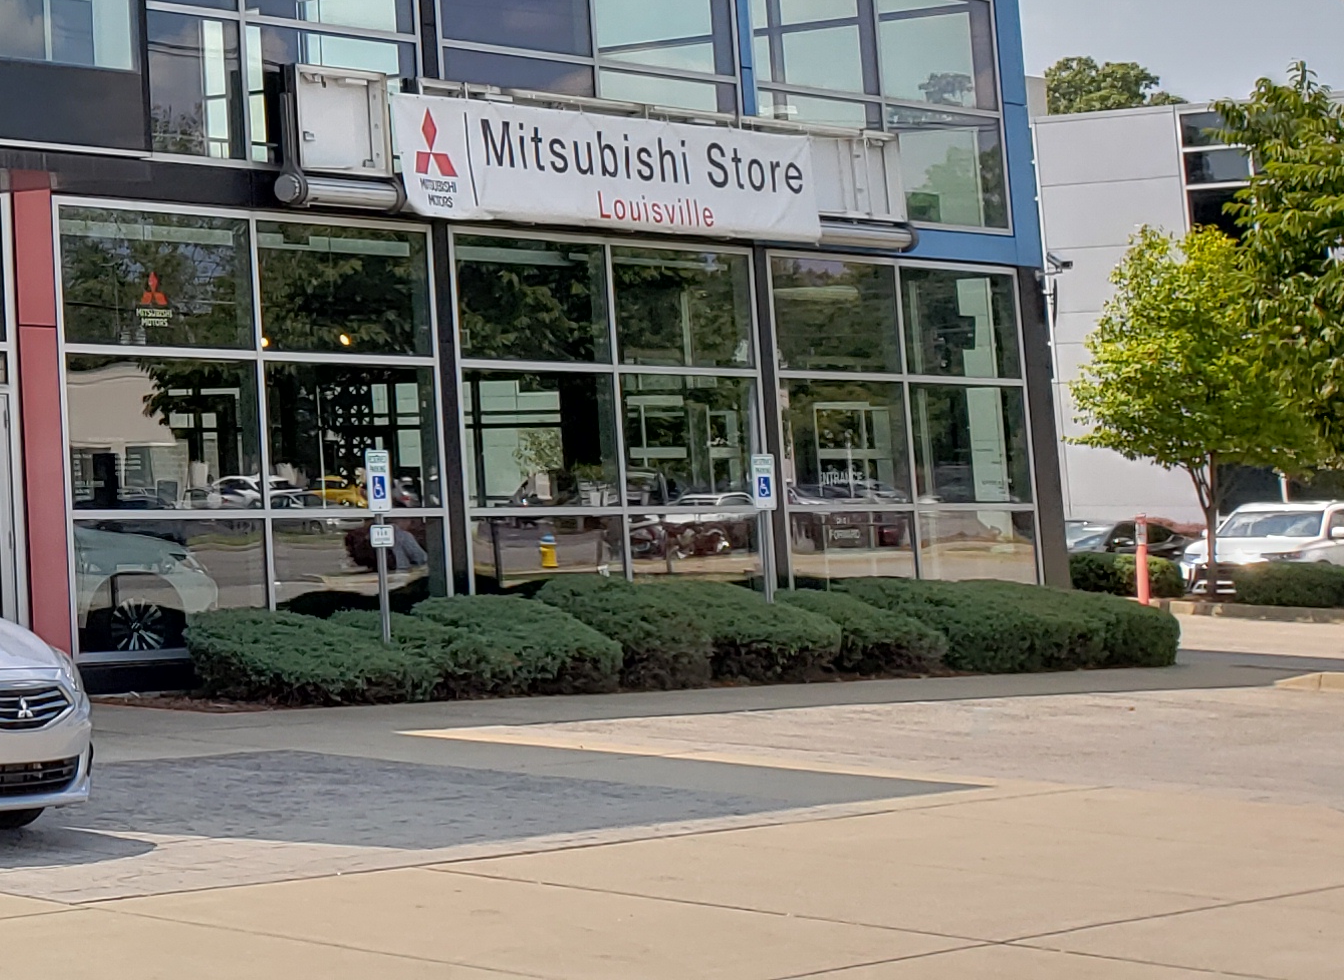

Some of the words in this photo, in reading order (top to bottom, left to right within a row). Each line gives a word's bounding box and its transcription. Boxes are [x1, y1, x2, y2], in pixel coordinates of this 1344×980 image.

[479, 118, 691, 185] Mitsubishi
[706, 141, 804, 195] Store
[419, 177, 458, 194] MITSUBISHI
[427, 193, 454, 209] MOTORS
[597, 190, 715, 228] Louisville
[135, 308, 173, 318] MITSUBISHI
[141, 317, 169, 327] MOTORS
